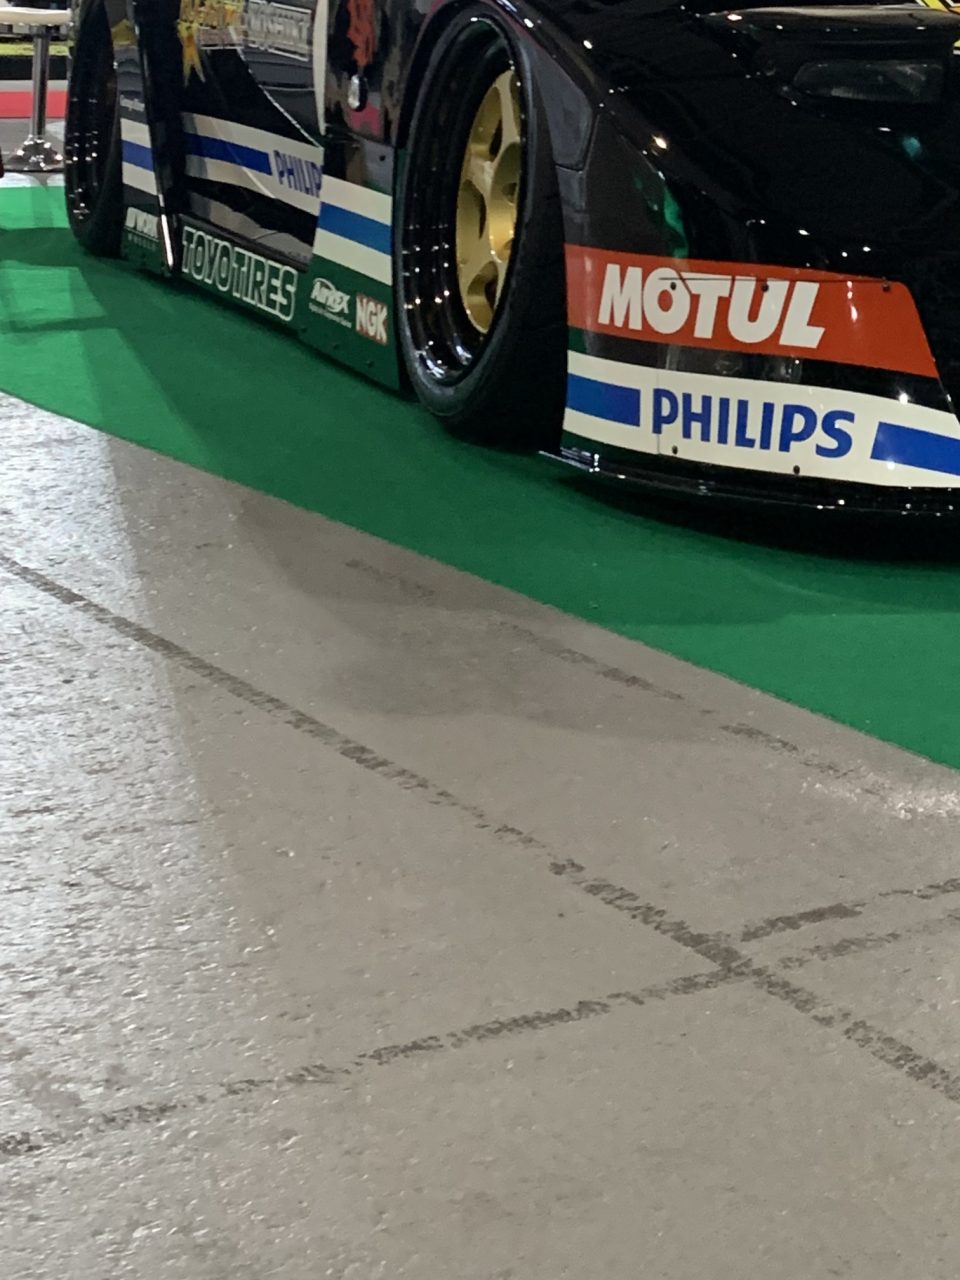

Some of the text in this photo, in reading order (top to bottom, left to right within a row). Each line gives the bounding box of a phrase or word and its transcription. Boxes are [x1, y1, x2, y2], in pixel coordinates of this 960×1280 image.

[273, 149, 322, 199] PHILIP
[355, 293, 388, 346] NGK
[597, 263, 826, 349] MOTUL
[652, 388, 856, 459] PHILIPS
